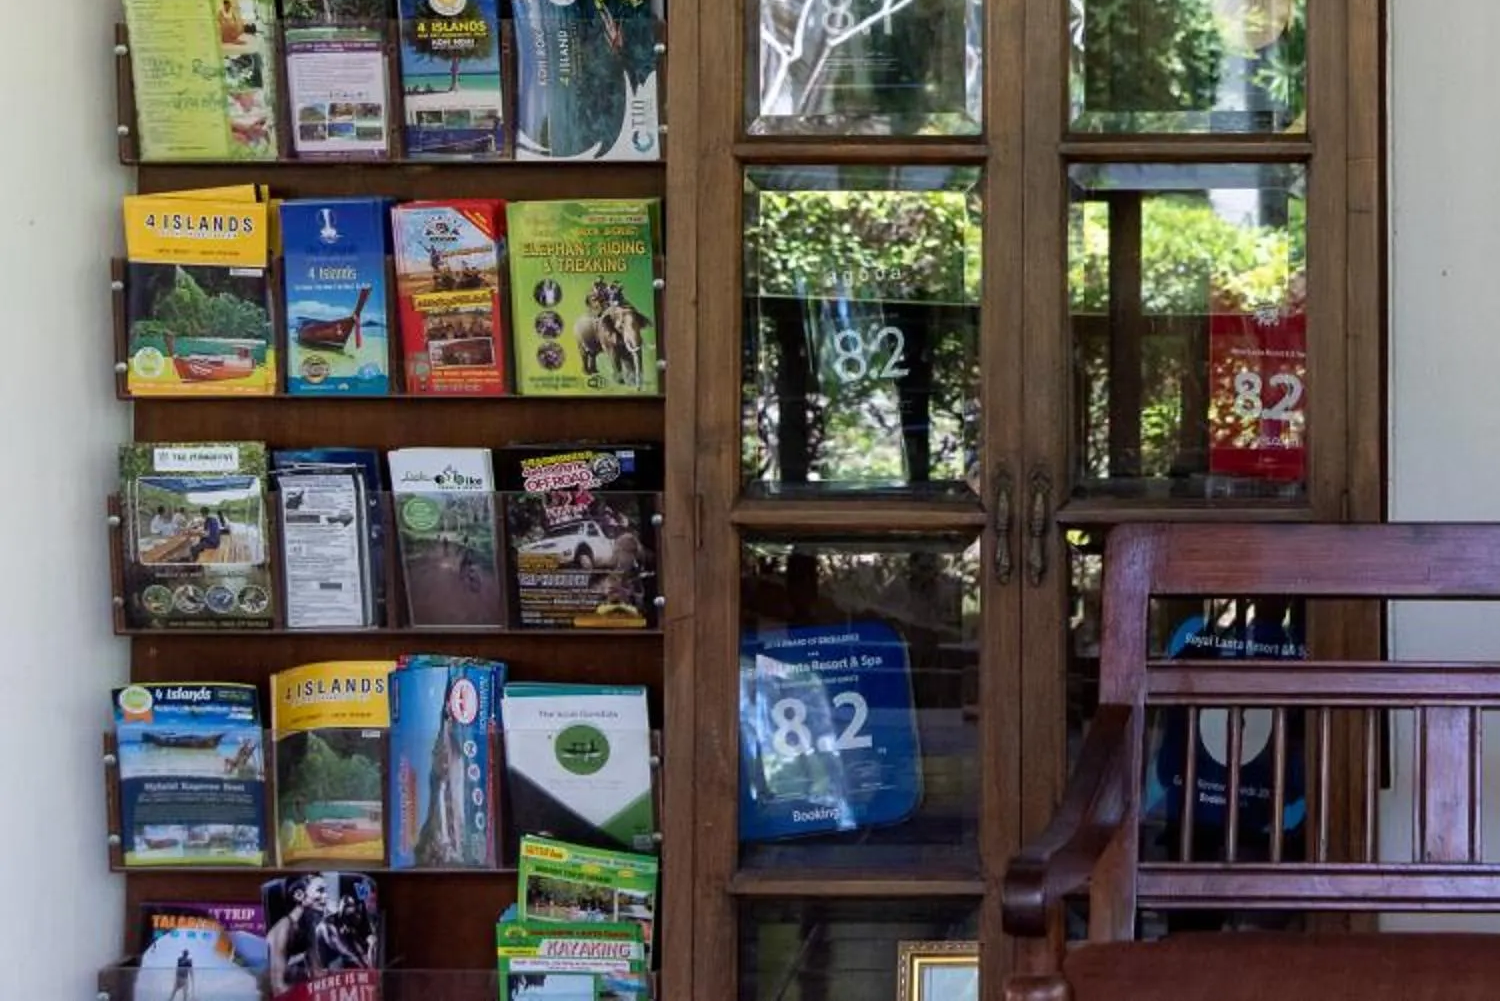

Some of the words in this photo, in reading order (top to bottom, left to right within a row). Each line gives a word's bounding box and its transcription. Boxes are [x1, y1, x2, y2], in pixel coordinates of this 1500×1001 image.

[417, 21, 426, 32] 4
[431, 19, 487, 32] ISLANDS
[146, 213, 156, 227] 4
[163, 213, 254, 233] ISLANDS
[523, 240, 592, 257] ELEPHANT
[597, 239, 646, 256] RIDING
[558, 258, 627, 273] TREKKING
[1215, 635, 1244, 651] Lanta
[812, 656, 848, 672] Resort
[860, 654, 883, 670] Spa
[296, 678, 385, 699] ISLANDS
[223, 908, 255, 920] TRIP
[547, 940, 631, 959] KAYAKING
